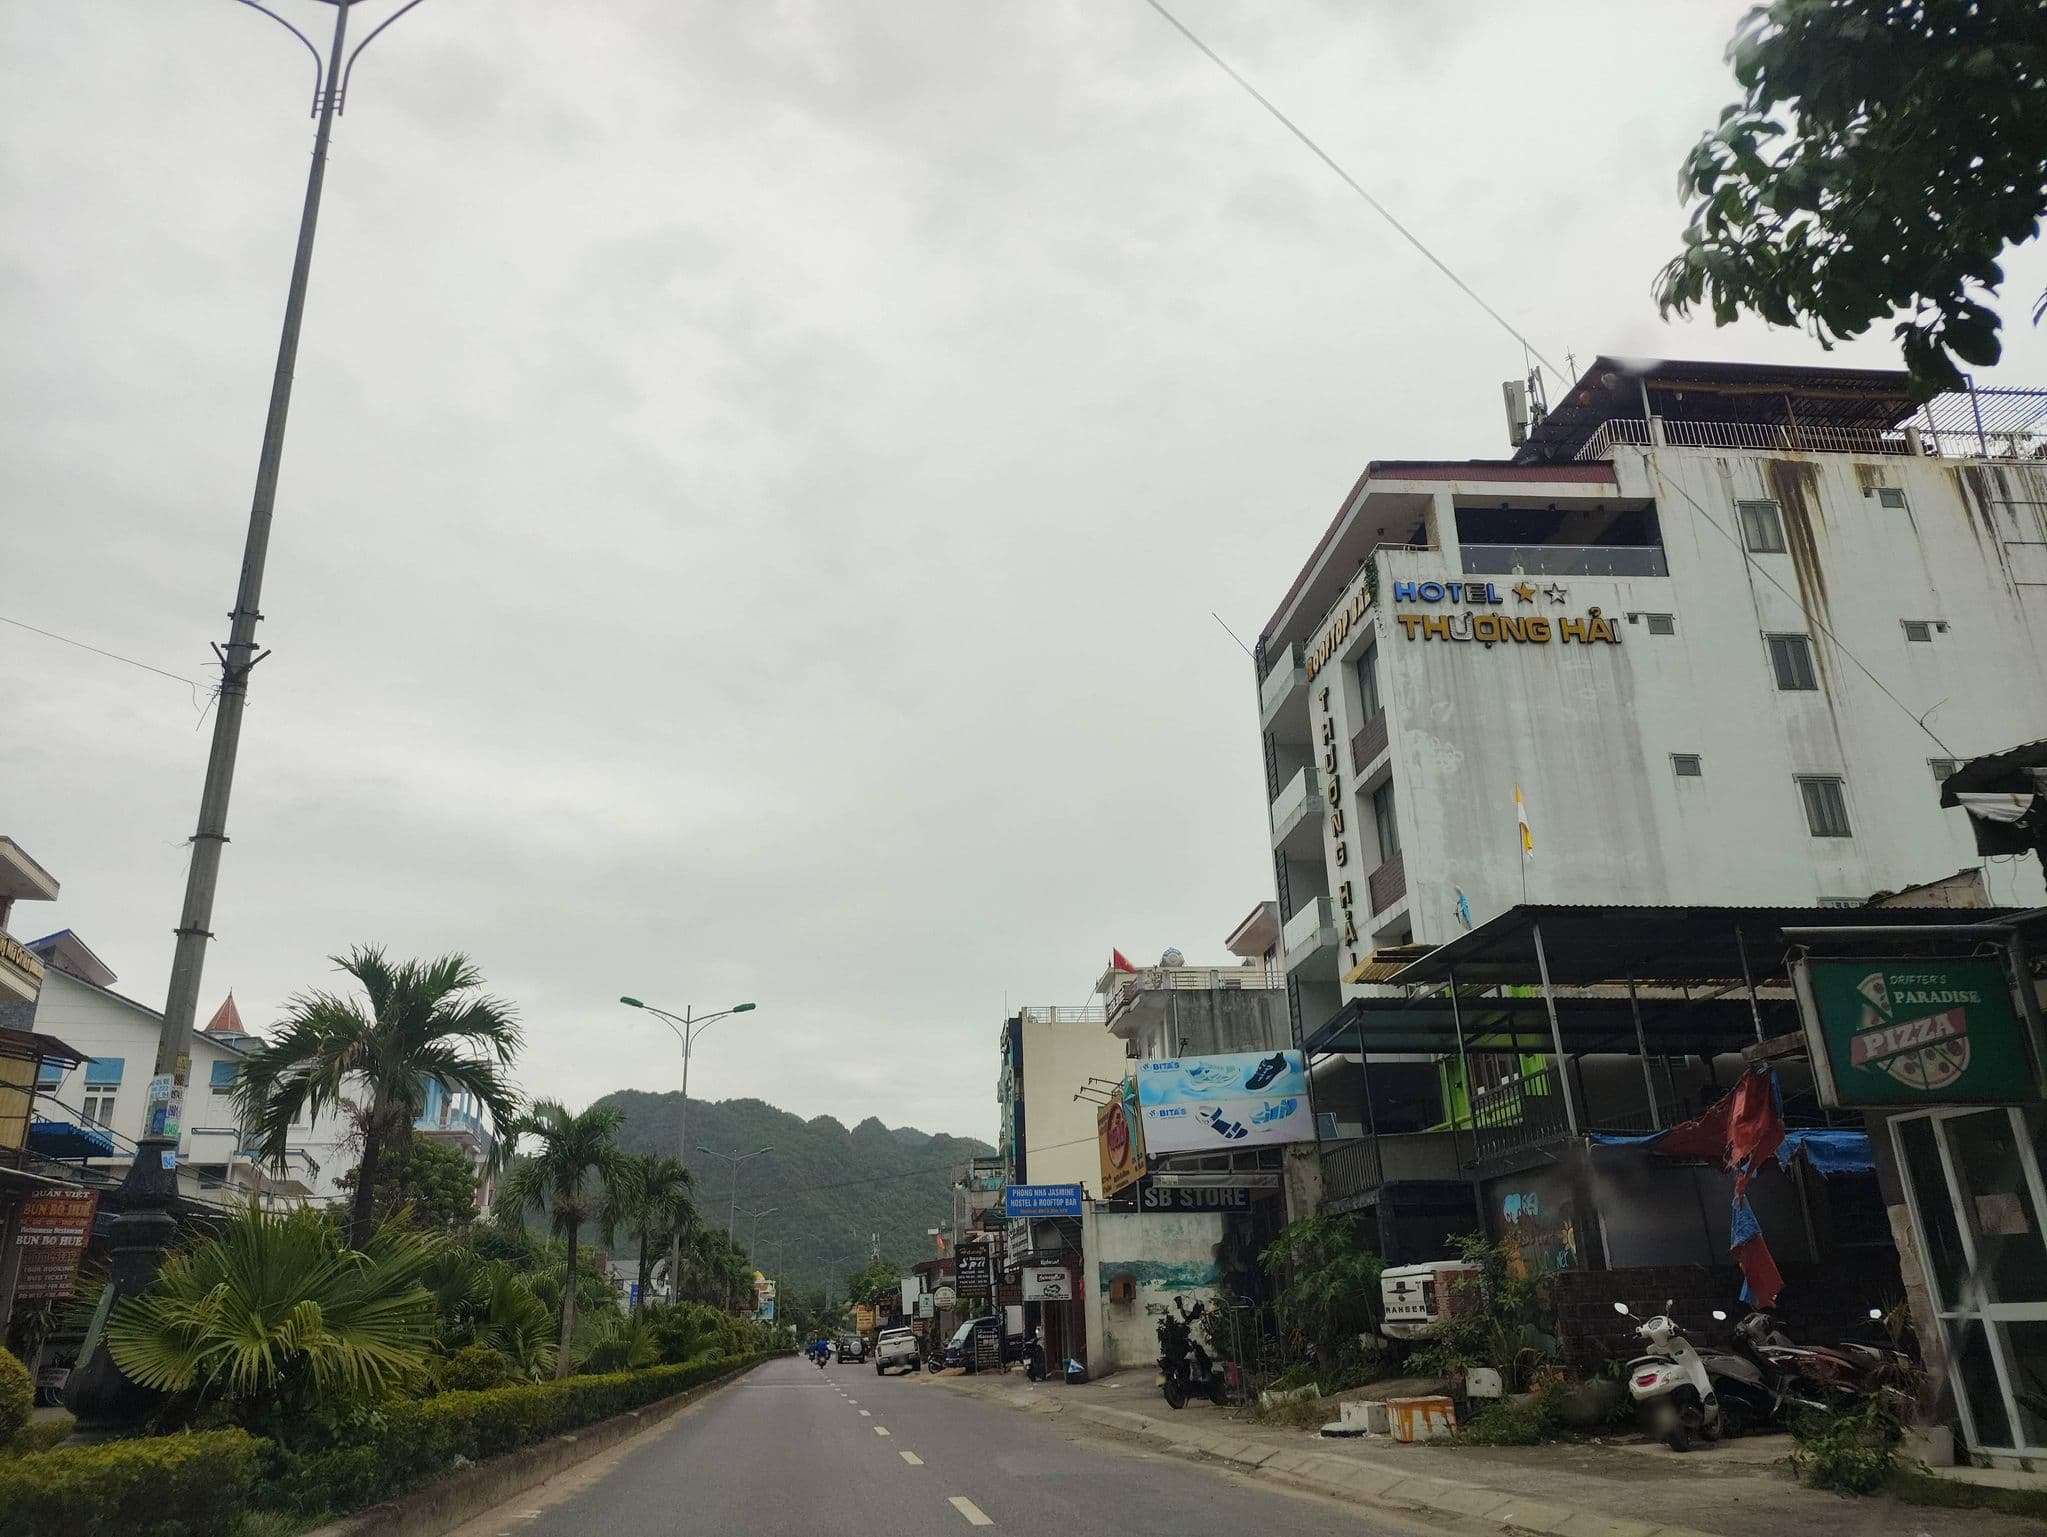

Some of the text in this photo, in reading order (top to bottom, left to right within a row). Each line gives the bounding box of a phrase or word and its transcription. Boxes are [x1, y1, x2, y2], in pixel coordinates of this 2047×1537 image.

[1394, 580, 1503, 604] HOTEL
[1398, 606, 1624, 649] THƯỢNG HẢI
[1889, 974, 1947, 985] DRIFTER'S
[1893, 991, 1981, 1004] PARADISE
[1863, 1012, 1957, 1059] PIZZA
[1047, 1188, 1075, 1196] JASMINE
[1144, 1187, 1247, 1208] SB STORE
[1038, 1199, 1065, 1207] ROOFTOP
[16, 1235, 83, 1246] BUN BO HUE
[1386, 1305, 1425, 1314] RANGER
